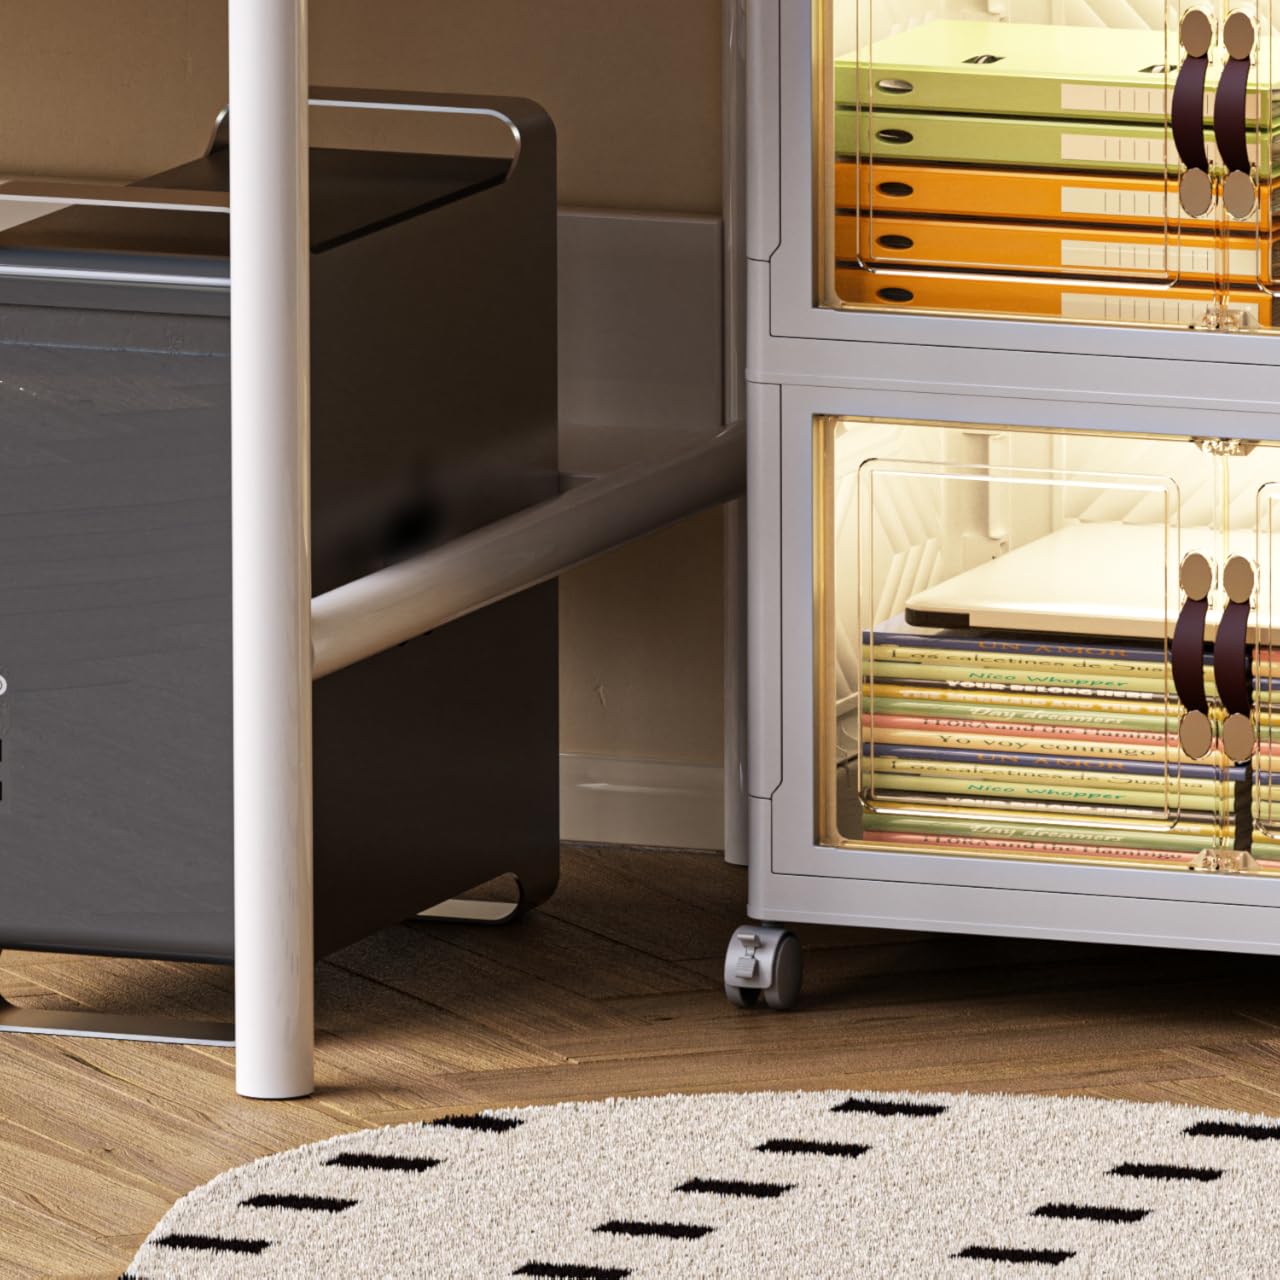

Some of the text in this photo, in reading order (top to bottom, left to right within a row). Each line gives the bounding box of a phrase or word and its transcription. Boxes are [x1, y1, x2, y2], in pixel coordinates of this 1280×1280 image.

[1072, 659, 1102, 669] de
[968, 672, 1129, 687] Nico Whopper
[939, 735, 1156, 757] Yo voy conmigo
[967, 784, 1127, 800] Nico Whopper
